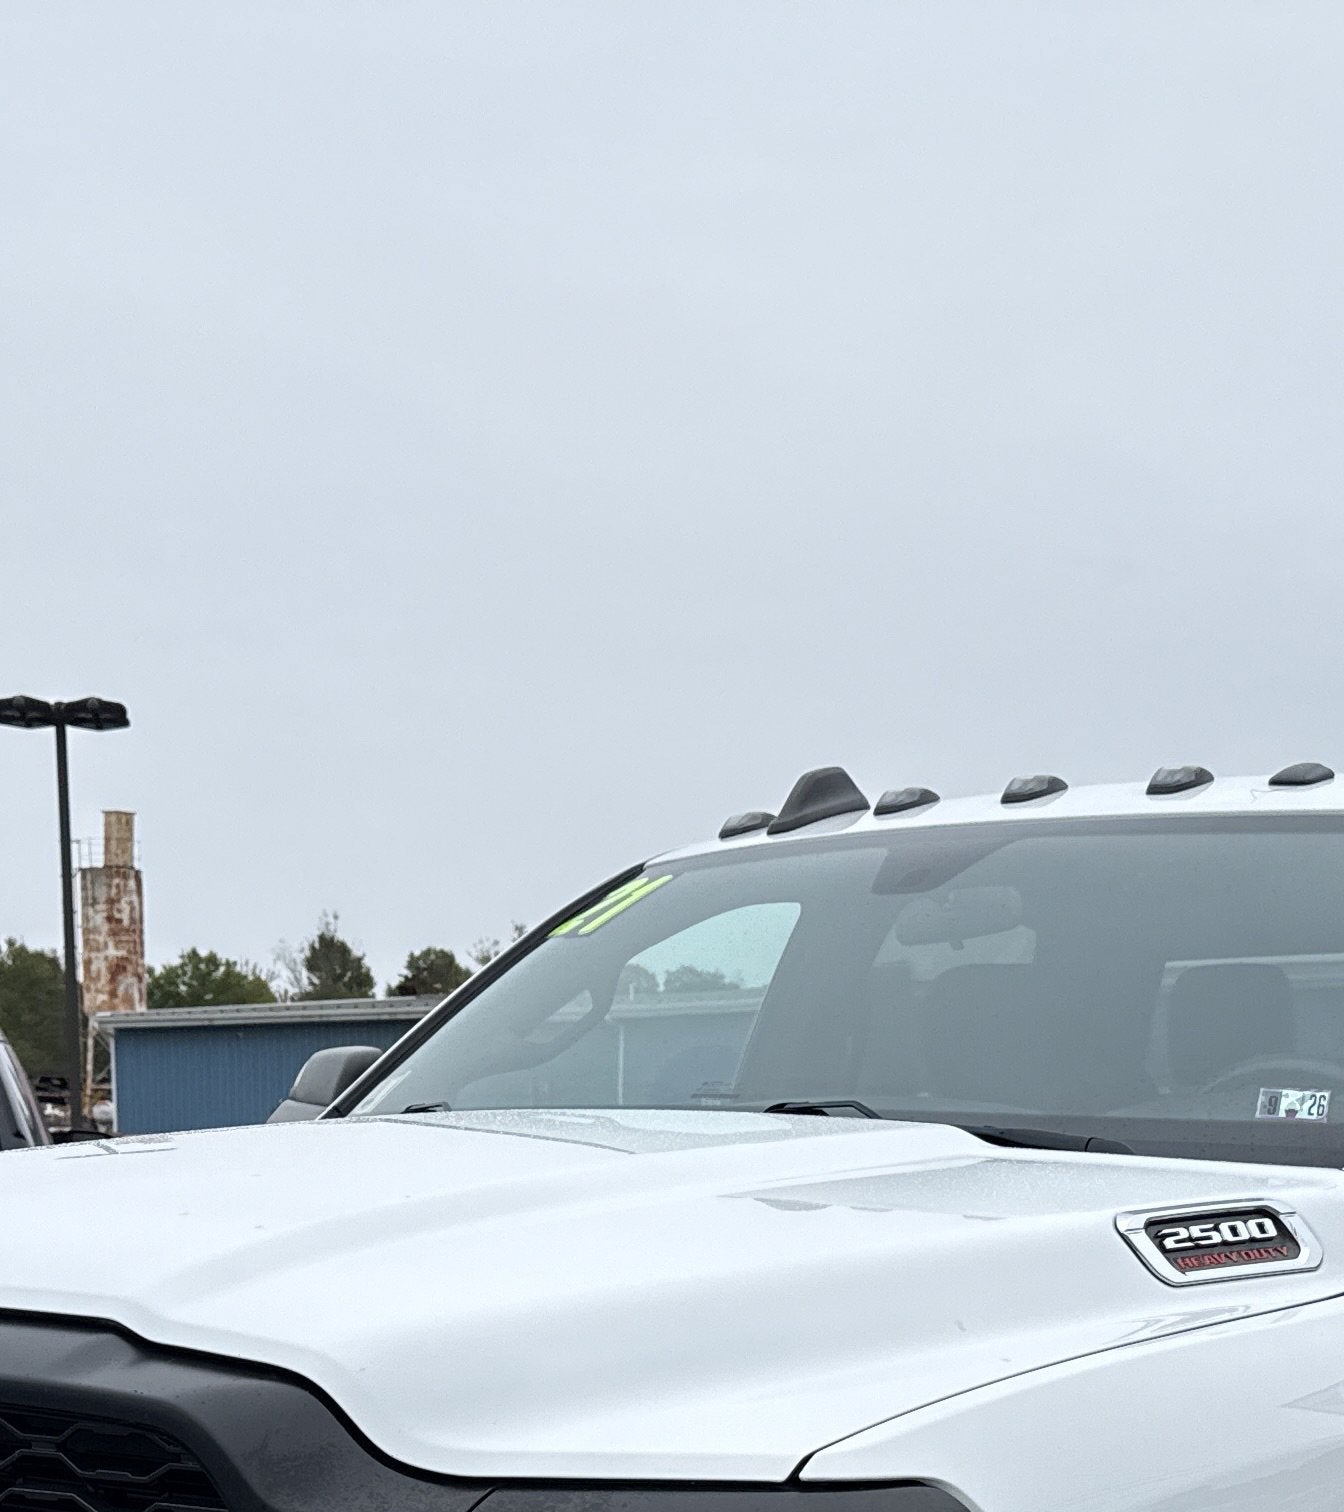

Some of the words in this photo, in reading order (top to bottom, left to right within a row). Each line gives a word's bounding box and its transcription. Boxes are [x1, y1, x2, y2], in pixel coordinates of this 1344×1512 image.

[1267, 1095, 1279, 1115] 9
[1307, 1094, 1327, 1116] 26
[1155, 1218, 1278, 1251] 2500
[1174, 1252, 1239, 1270] HEAVY
[1239, 1246, 1290, 1261] DUTY
